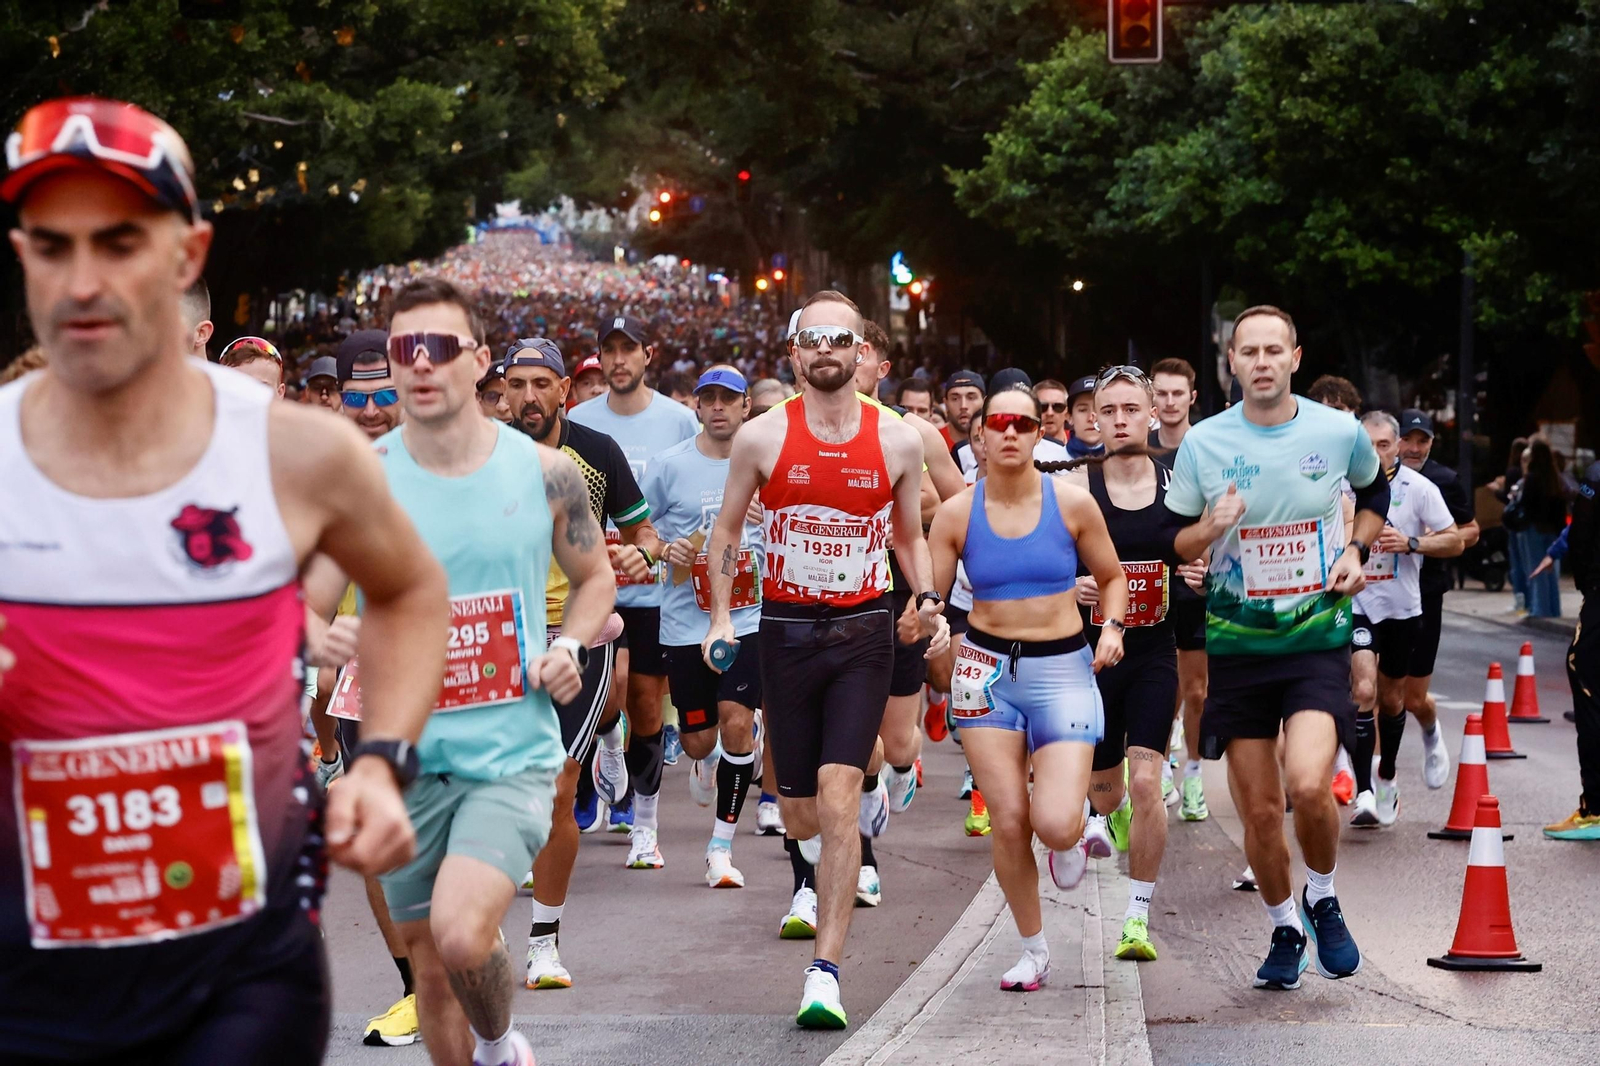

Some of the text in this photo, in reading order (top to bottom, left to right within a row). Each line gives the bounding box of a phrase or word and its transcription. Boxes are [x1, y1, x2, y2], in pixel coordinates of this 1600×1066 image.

[1222, 464, 1260, 479] EXPLORER
[847, 478, 871, 488] MÁLAGA
[811, 524, 862, 537] GENERALI
[803, 540, 851, 558] 19381
[1256, 540, 1306, 558] 17216
[1128, 579, 1147, 591] 02
[449, 596, 504, 617] NERALI
[447, 622, 490, 648] 295
[1134, 751, 1153, 762] 2003
[66, 785, 182, 836] 3183
